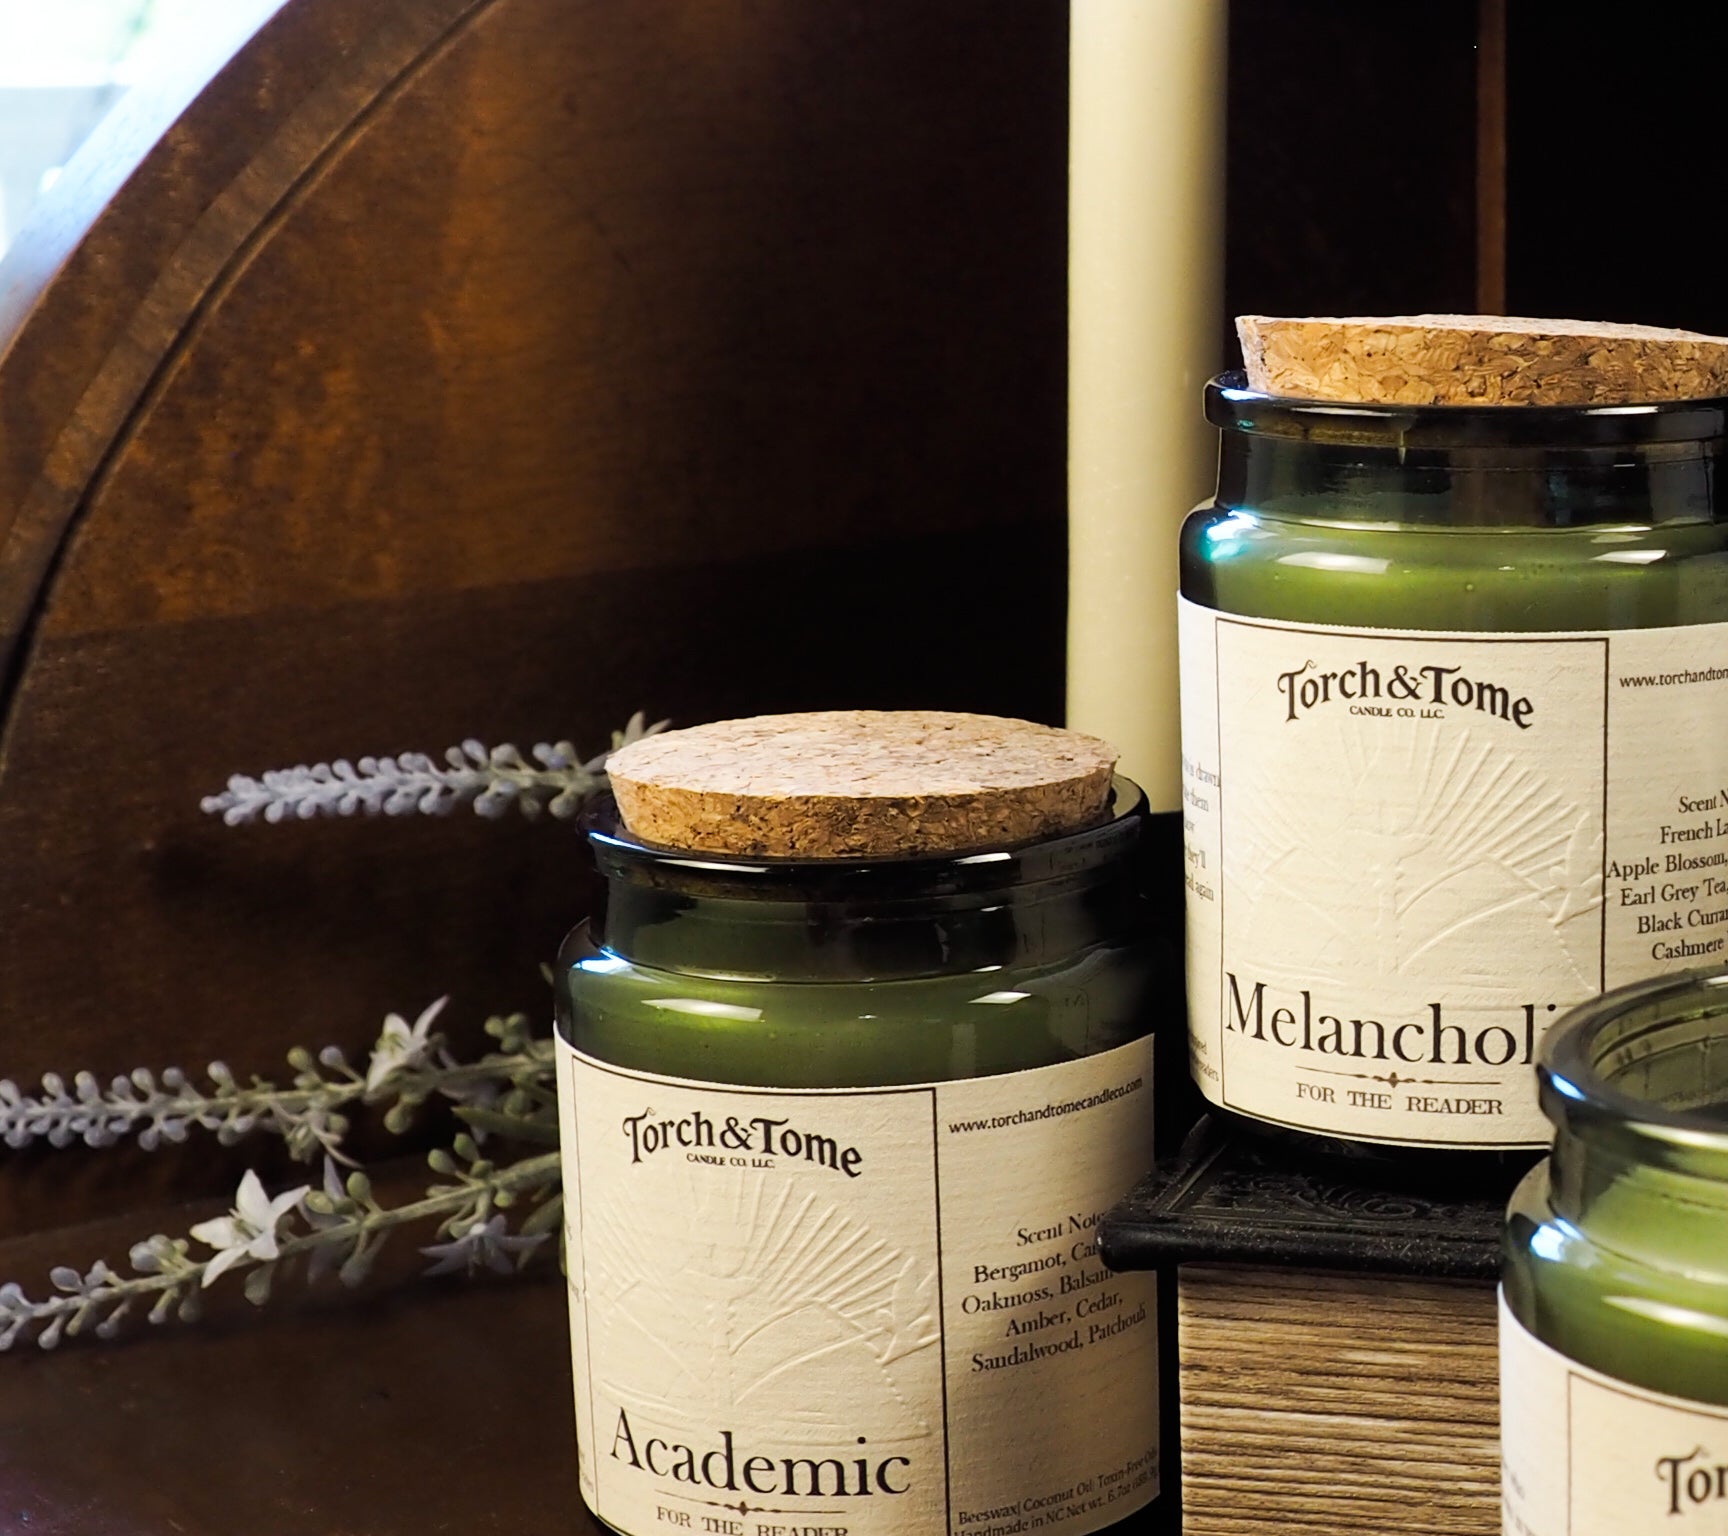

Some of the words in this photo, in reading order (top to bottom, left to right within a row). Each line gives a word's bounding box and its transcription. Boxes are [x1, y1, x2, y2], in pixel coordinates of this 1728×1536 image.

[1349, 704, 1394, 718] CANDLE
[1677, 794, 1718, 815] Scent
[1659, 819, 1714, 846] French
[1605, 856, 1660, 882] Apple
[1665, 851, 1728, 874] Blossom,
[1619, 884, 1656, 908] Earl
[1660, 883, 1701, 904] Grey
[1636, 910, 1683, 936] Black
[1651, 935, 1726, 962] Cashmere
[1223, 971, 1557, 1067] Melanchol
[947, 1076, 1144, 1134] www.torchandtomecandleco.com
[1295, 1081, 1337, 1105] FOR
[1346, 1089, 1393, 1112] THE
[1405, 1095, 1504, 1116] READER
[685, 1151, 727, 1167] CANDLE
[1015, 1222, 1064, 1248] Scent
[973, 1250, 1067, 1285] Bergamot,
[960, 1285, 1055, 1315] Oakmoss,
[1005, 1310, 1073, 1338] Amber,
[1075, 1289, 1124, 1319] Cedar,
[970, 1328, 1085, 1373] Sandalwood,
[609, 1405, 911, 1497] Academic
[1022, 1487, 1075, 1513] Coconut
[655, 1505, 692, 1528] FOR
[1030, 1515, 1044, 1529] in
[1045, 1507, 1066, 1525] NC
[1065, 1502, 1087, 1520] Net
